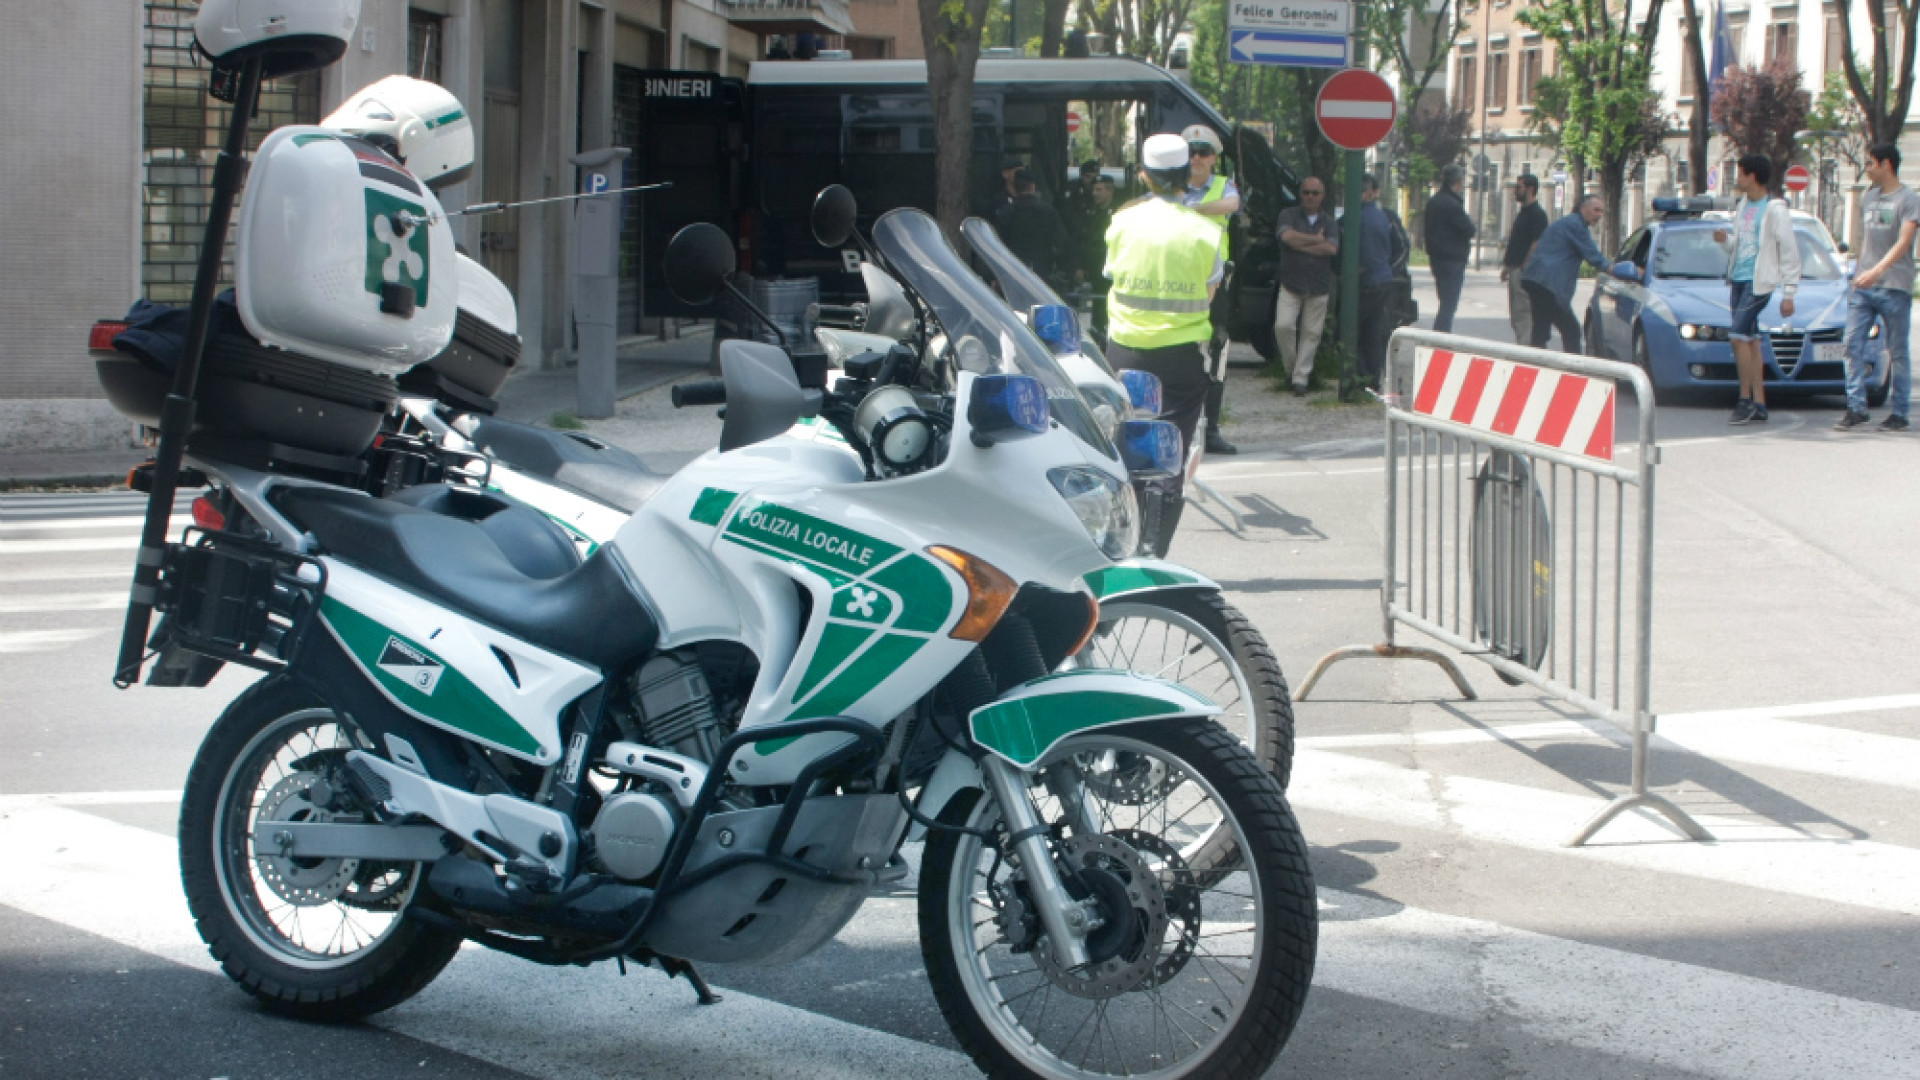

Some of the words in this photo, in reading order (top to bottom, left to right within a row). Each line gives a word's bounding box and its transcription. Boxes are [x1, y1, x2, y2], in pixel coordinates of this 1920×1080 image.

[1234, 3, 1274, 18] Felice
[1280, 6, 1338, 21] Geromini
[592, 173, 606, 194] P
[739, 507, 799, 541] POLIZIA
[802, 527, 874, 566] LOCALE
[420, 671, 430, 686] 3
